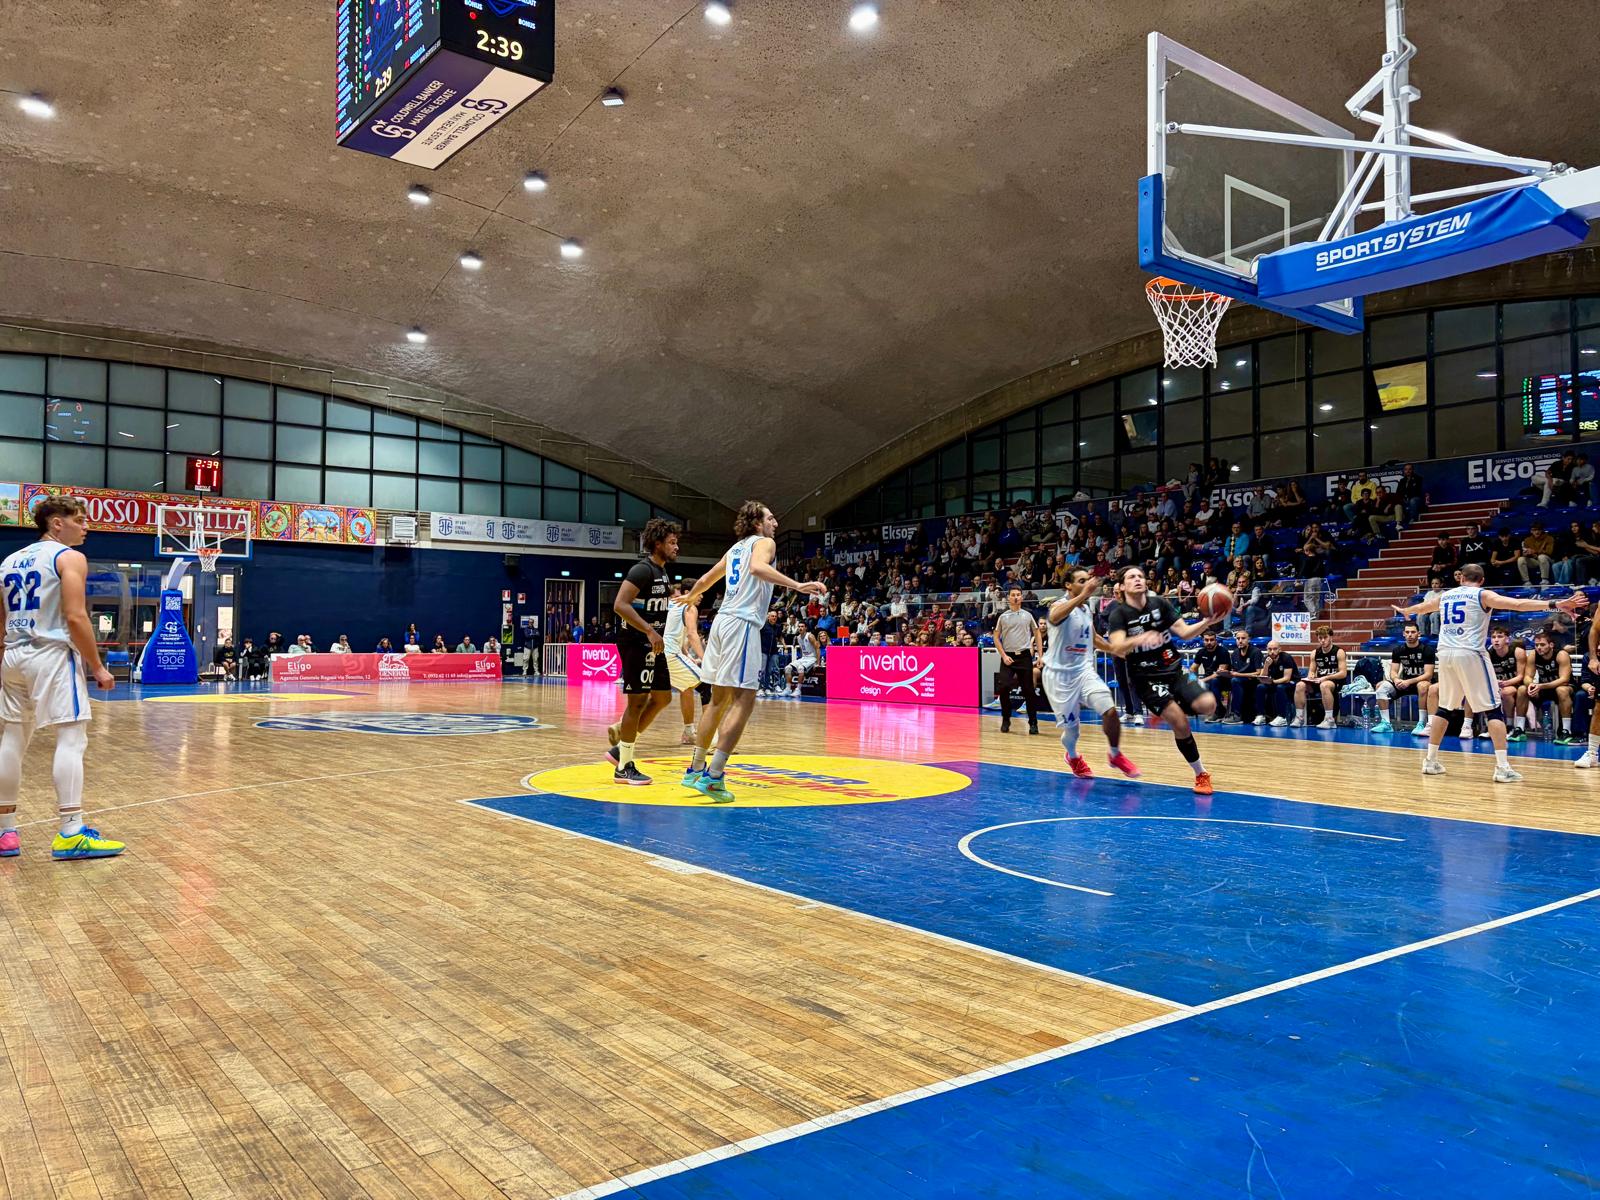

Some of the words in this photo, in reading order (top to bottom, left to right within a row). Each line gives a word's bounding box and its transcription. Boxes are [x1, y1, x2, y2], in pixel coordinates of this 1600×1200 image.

[518, 18, 536, 30] BONUS
[476, 30, 523, 60] 2:39
[390, 98, 423, 124] COLDWELL
[416, 80, 444, 104] BANKER
[1316, 212, 1472, 267] SPORTSYSTEM
[195, 459, 219, 469] 2:39
[1468, 459, 1534, 484] Ekso
[882, 525, 908, 541] Ekso
[729, 558, 741, 586] 5
[4, 571, 42, 612] 22
[1444, 601, 1467, 625] 15
[1079, 624, 1090, 639] 14
[158, 655, 185, 664] 1906
[582, 646, 610, 660] inventa
[860, 649, 918, 672] inventa
[860, 685, 881, 697] design
